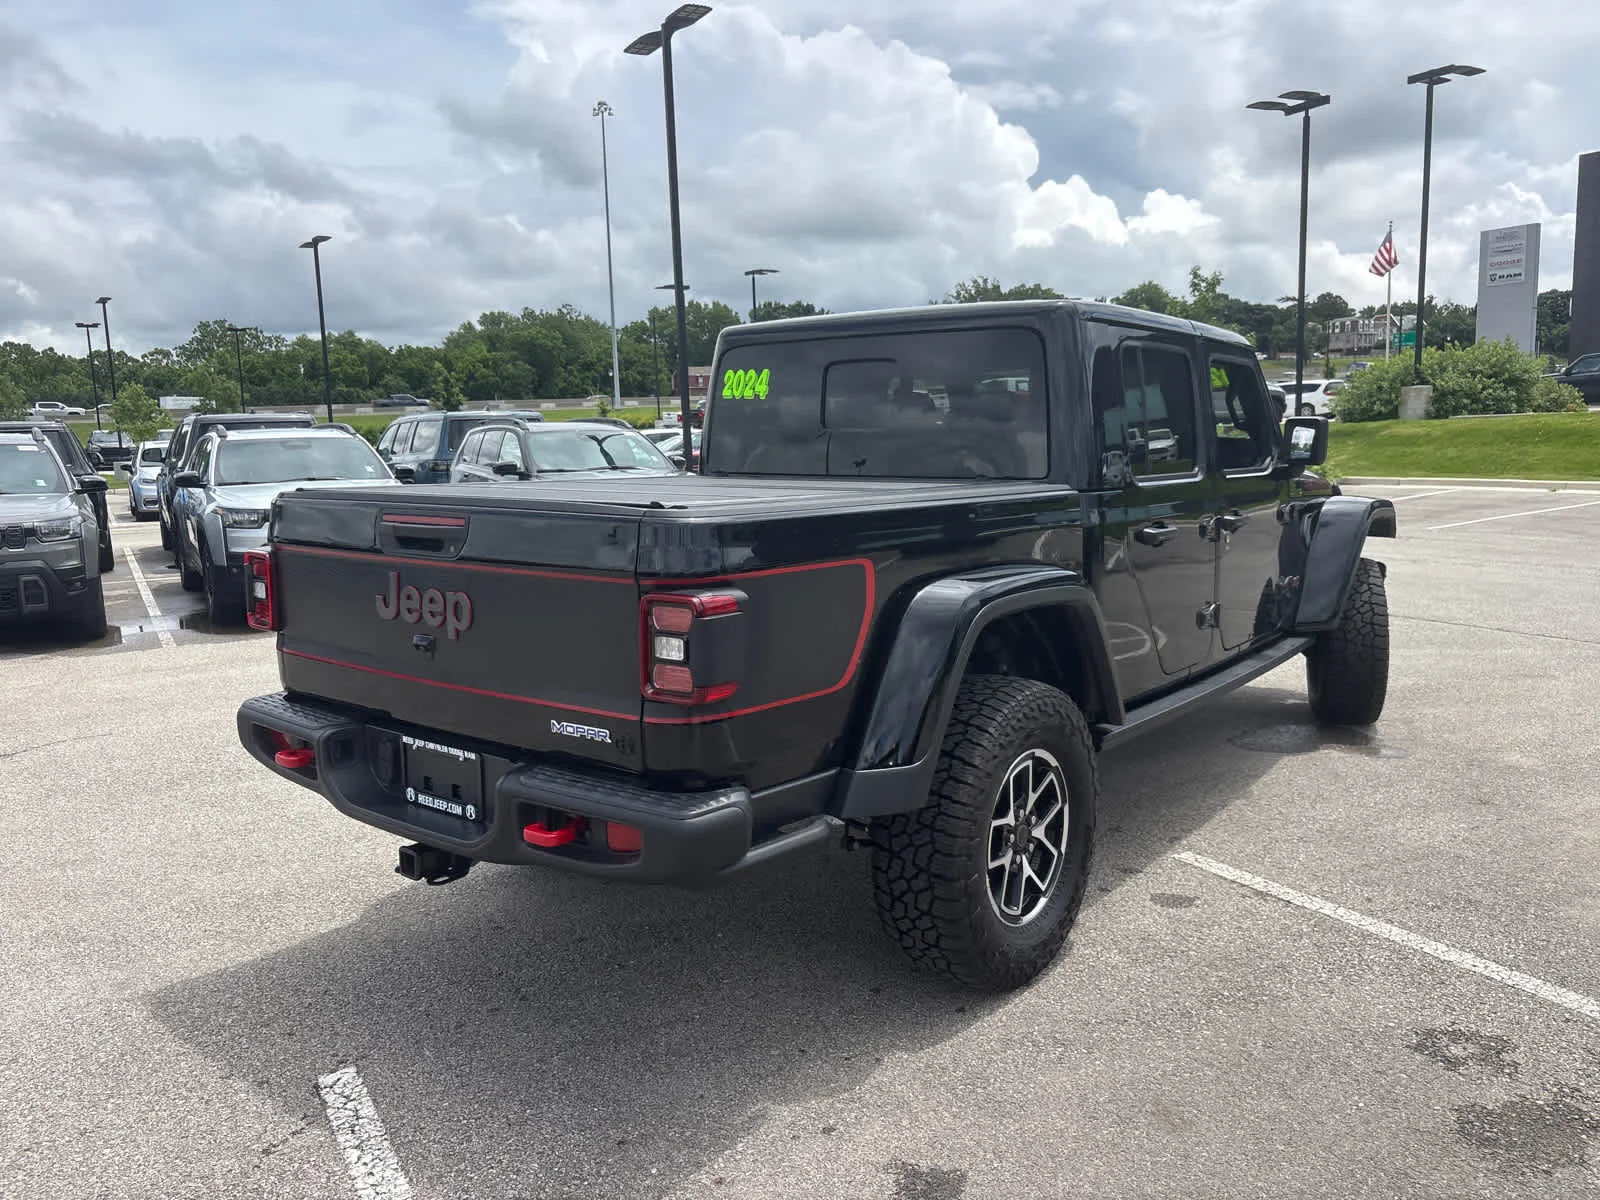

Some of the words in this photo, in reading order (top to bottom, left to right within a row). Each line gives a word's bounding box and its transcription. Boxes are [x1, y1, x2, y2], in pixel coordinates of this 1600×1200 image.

[722, 368, 770, 400] 2024
[375, 569, 473, 641] Jeep
[550, 719, 612, 743] MOPAR
[418, 793, 463, 816] REEDJEEP.COM
